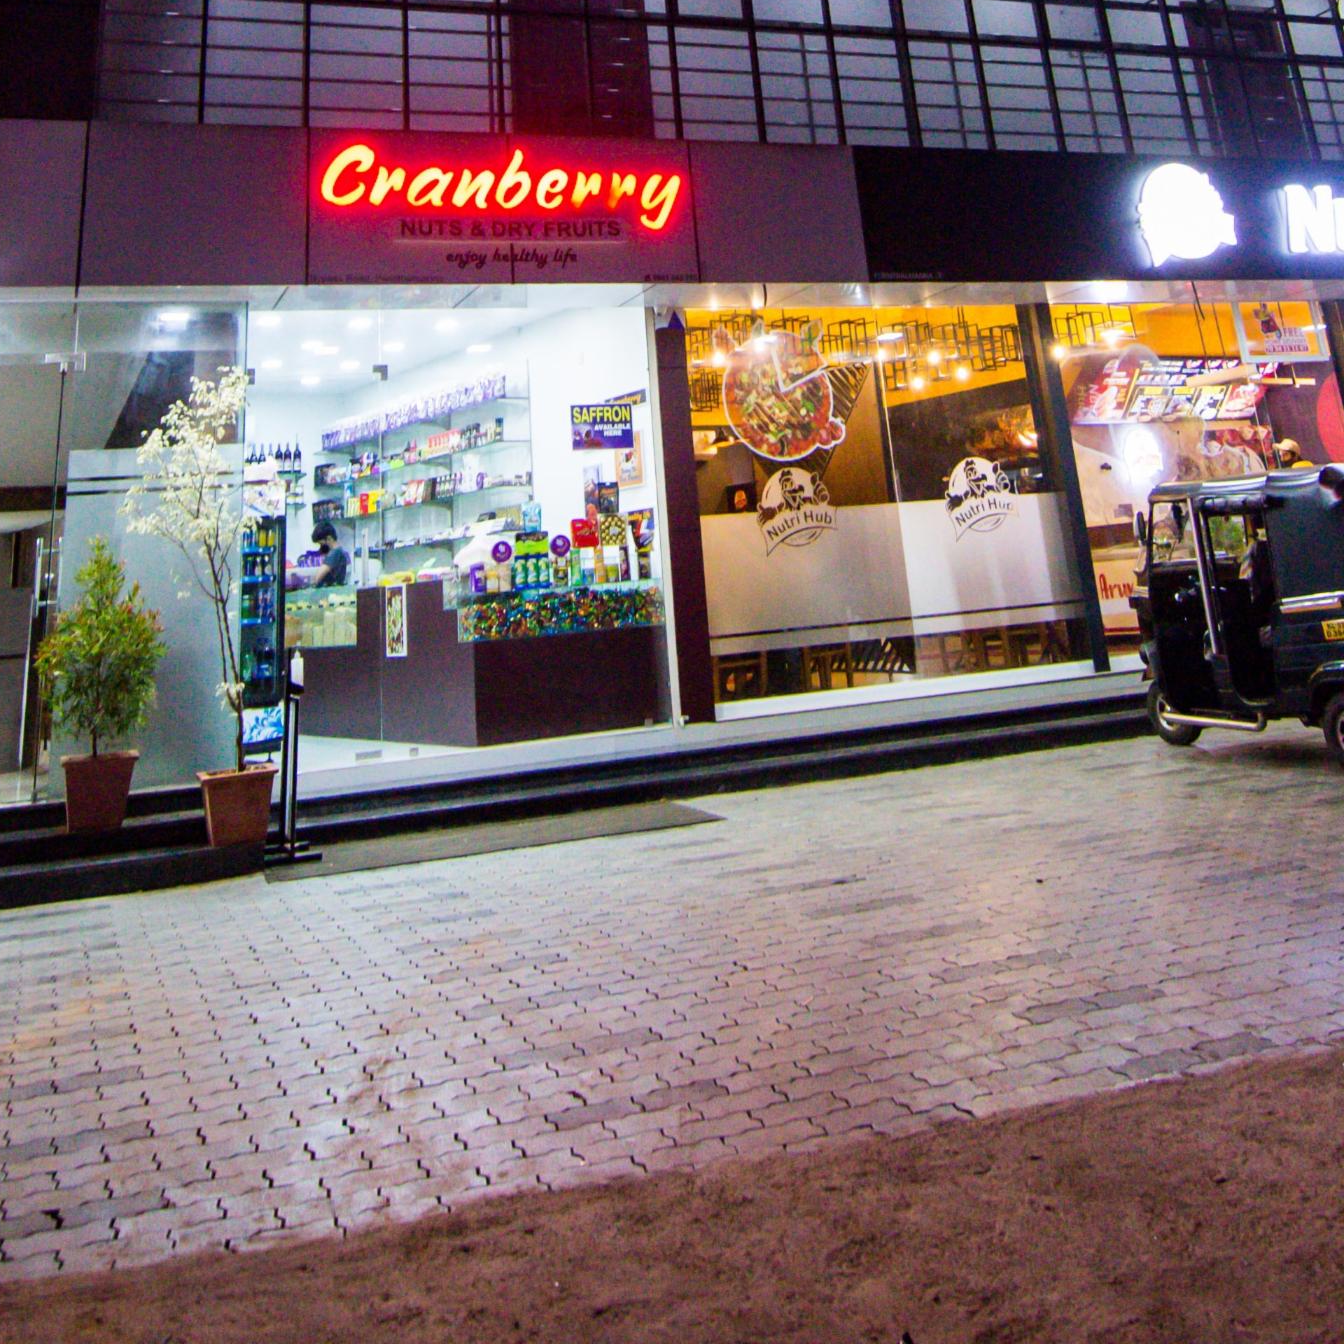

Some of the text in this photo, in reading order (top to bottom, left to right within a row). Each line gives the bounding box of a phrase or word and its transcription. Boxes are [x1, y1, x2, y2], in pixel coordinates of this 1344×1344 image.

[321, 144, 681, 230] Cranberry
[401, 219, 621, 237] NUTS & DRY FRUITS
[446, 248, 577, 269] enjoy healthy life
[573, 406, 630, 423] SAFFRON
[766, 510, 832, 541] Nutri Hub
[955, 503, 985, 527] Nutri
